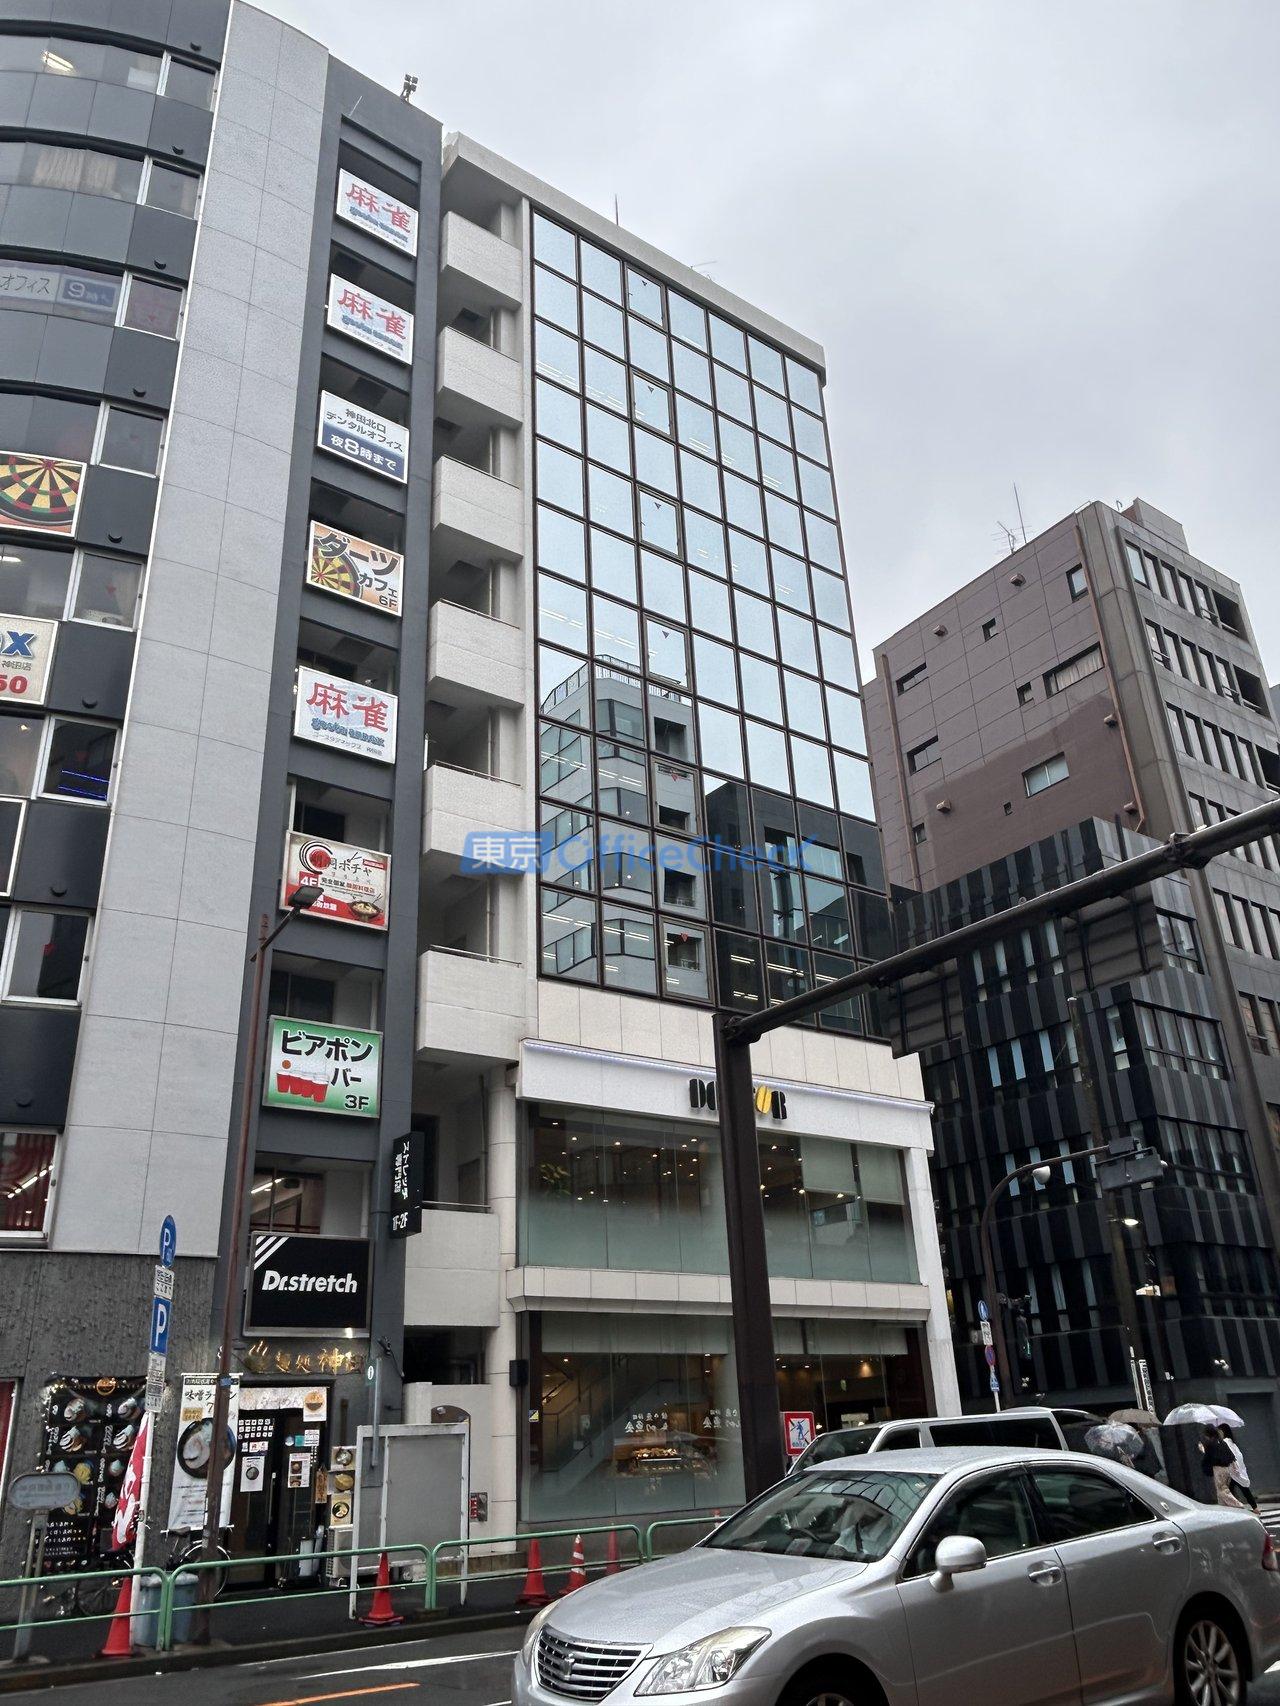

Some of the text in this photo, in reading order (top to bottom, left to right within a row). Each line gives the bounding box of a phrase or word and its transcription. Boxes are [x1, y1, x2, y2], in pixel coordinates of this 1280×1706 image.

[345, 183, 411, 233] 麻雀
[337, 288, 406, 340] 麻雀
[326, 411, 403, 452] デンタルオフィス
[345, 408, 386, 434] 神田北口
[330, 434, 397, 471] 夜8時まで
[319, 532, 399, 575] ダーツ
[358, 573, 398, 598] カフェ
[379, 595, 398, 608] 6F
[0, 630, 35, 656] X
[306, 682, 389, 733] 麻雀
[281, 1030, 373, 1062] ビアポン
[330, 1067, 362, 1087] バー
[344, 1094, 369, 1110] 3F
[689, 1078, 788, 1119] DOOR
[402, 1141, 410, 1199] ストレッチ
[163, 1228, 171, 1254] P
[262, 1270, 358, 1293] Dr.stretch
[155, 1303, 167, 1347] P
[184, 1389, 237, 1401] 味噌ラン
